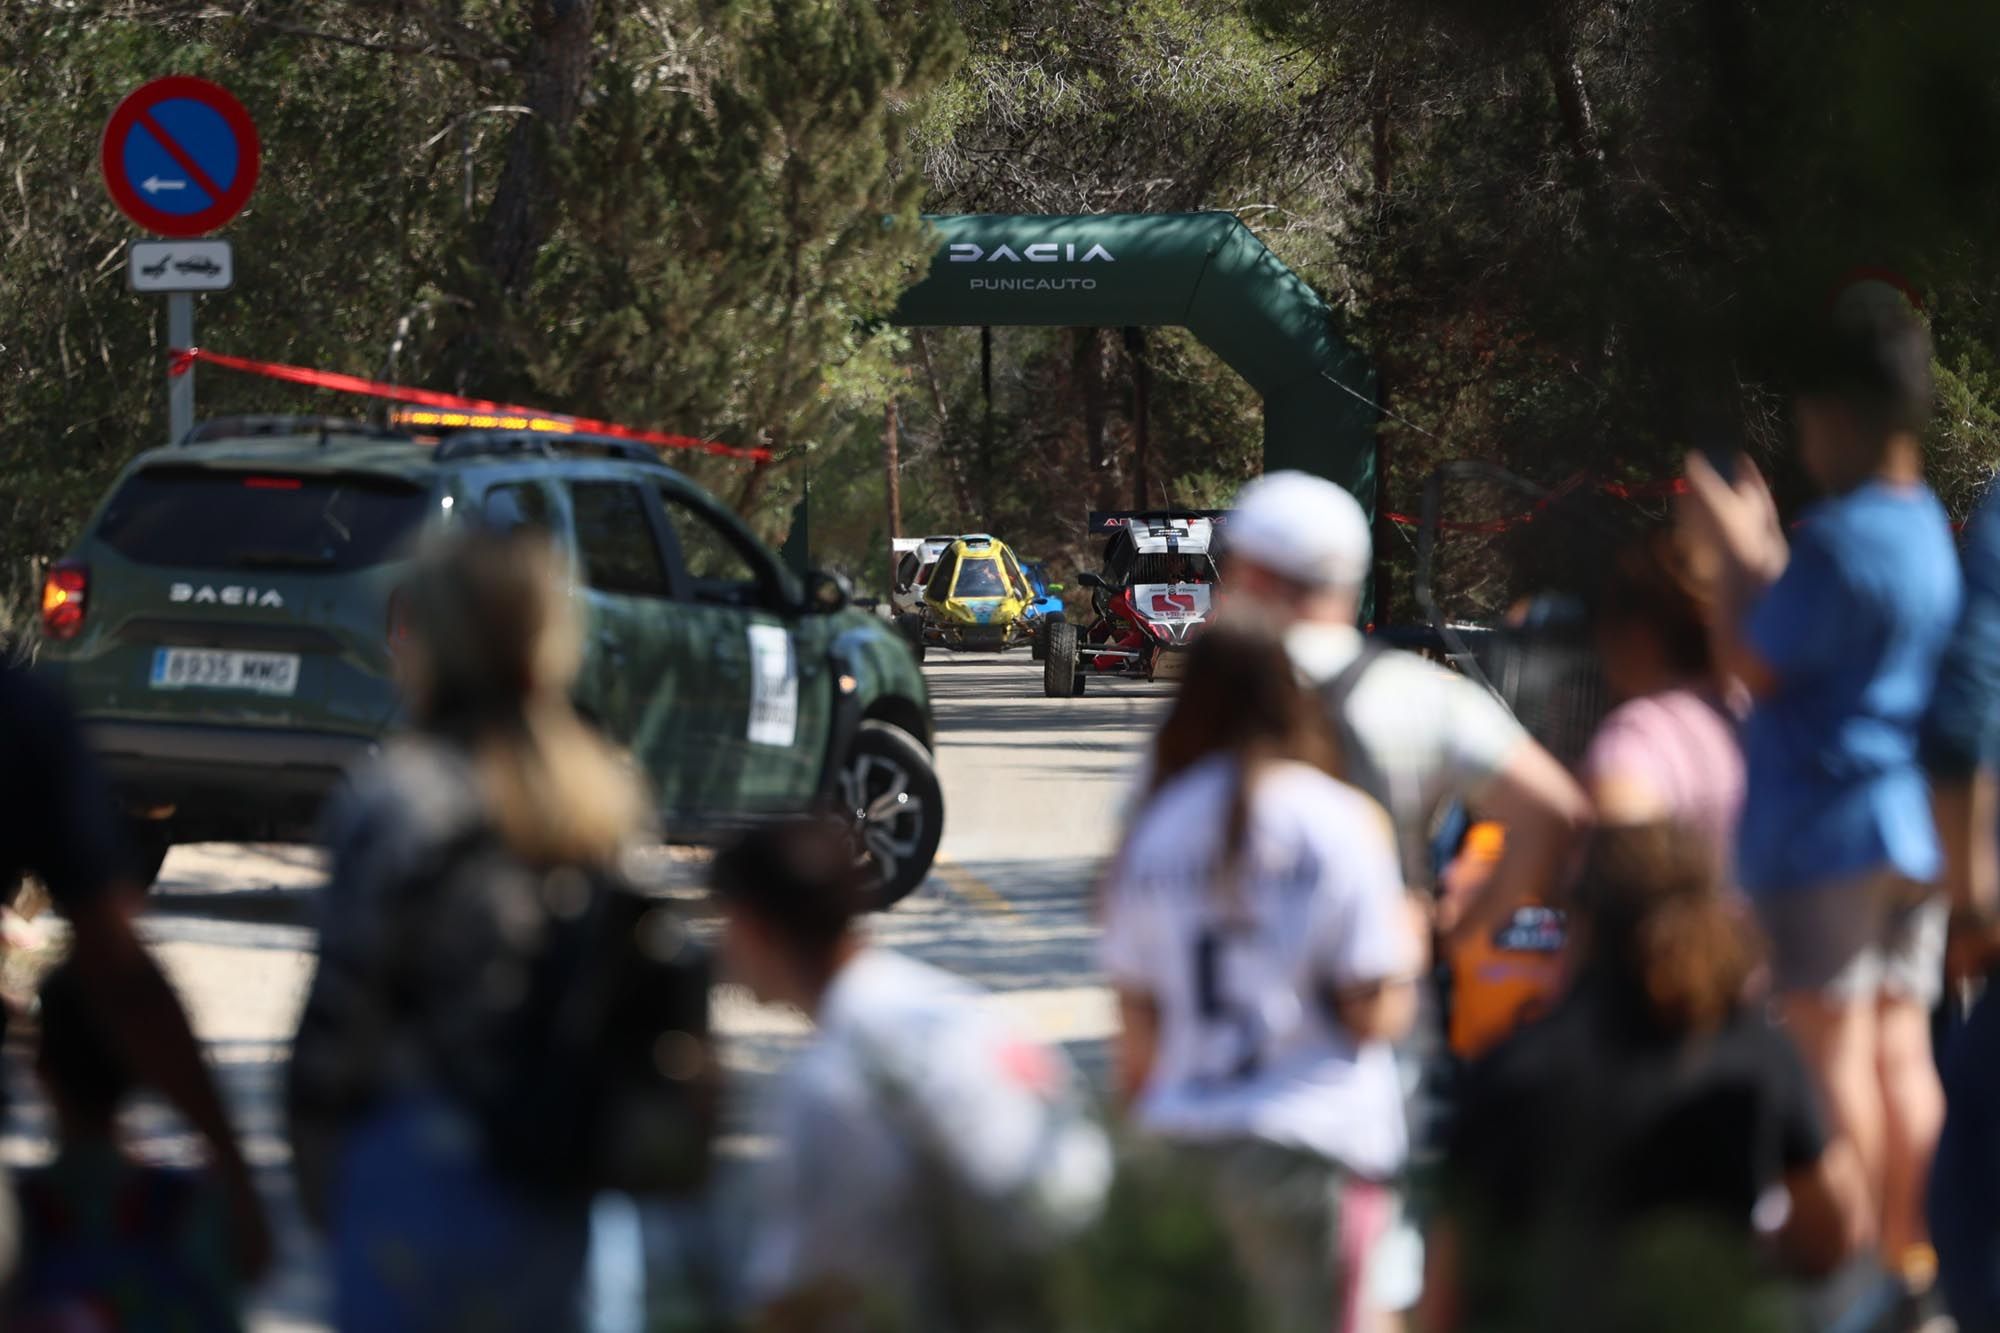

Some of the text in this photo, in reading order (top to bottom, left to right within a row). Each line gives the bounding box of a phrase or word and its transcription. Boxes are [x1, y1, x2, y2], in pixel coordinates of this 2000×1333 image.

[950, 243, 1115, 262] DACIA
[970, 278, 1097, 291] PUNICAUTO
[169, 582, 283, 608] DACIA
